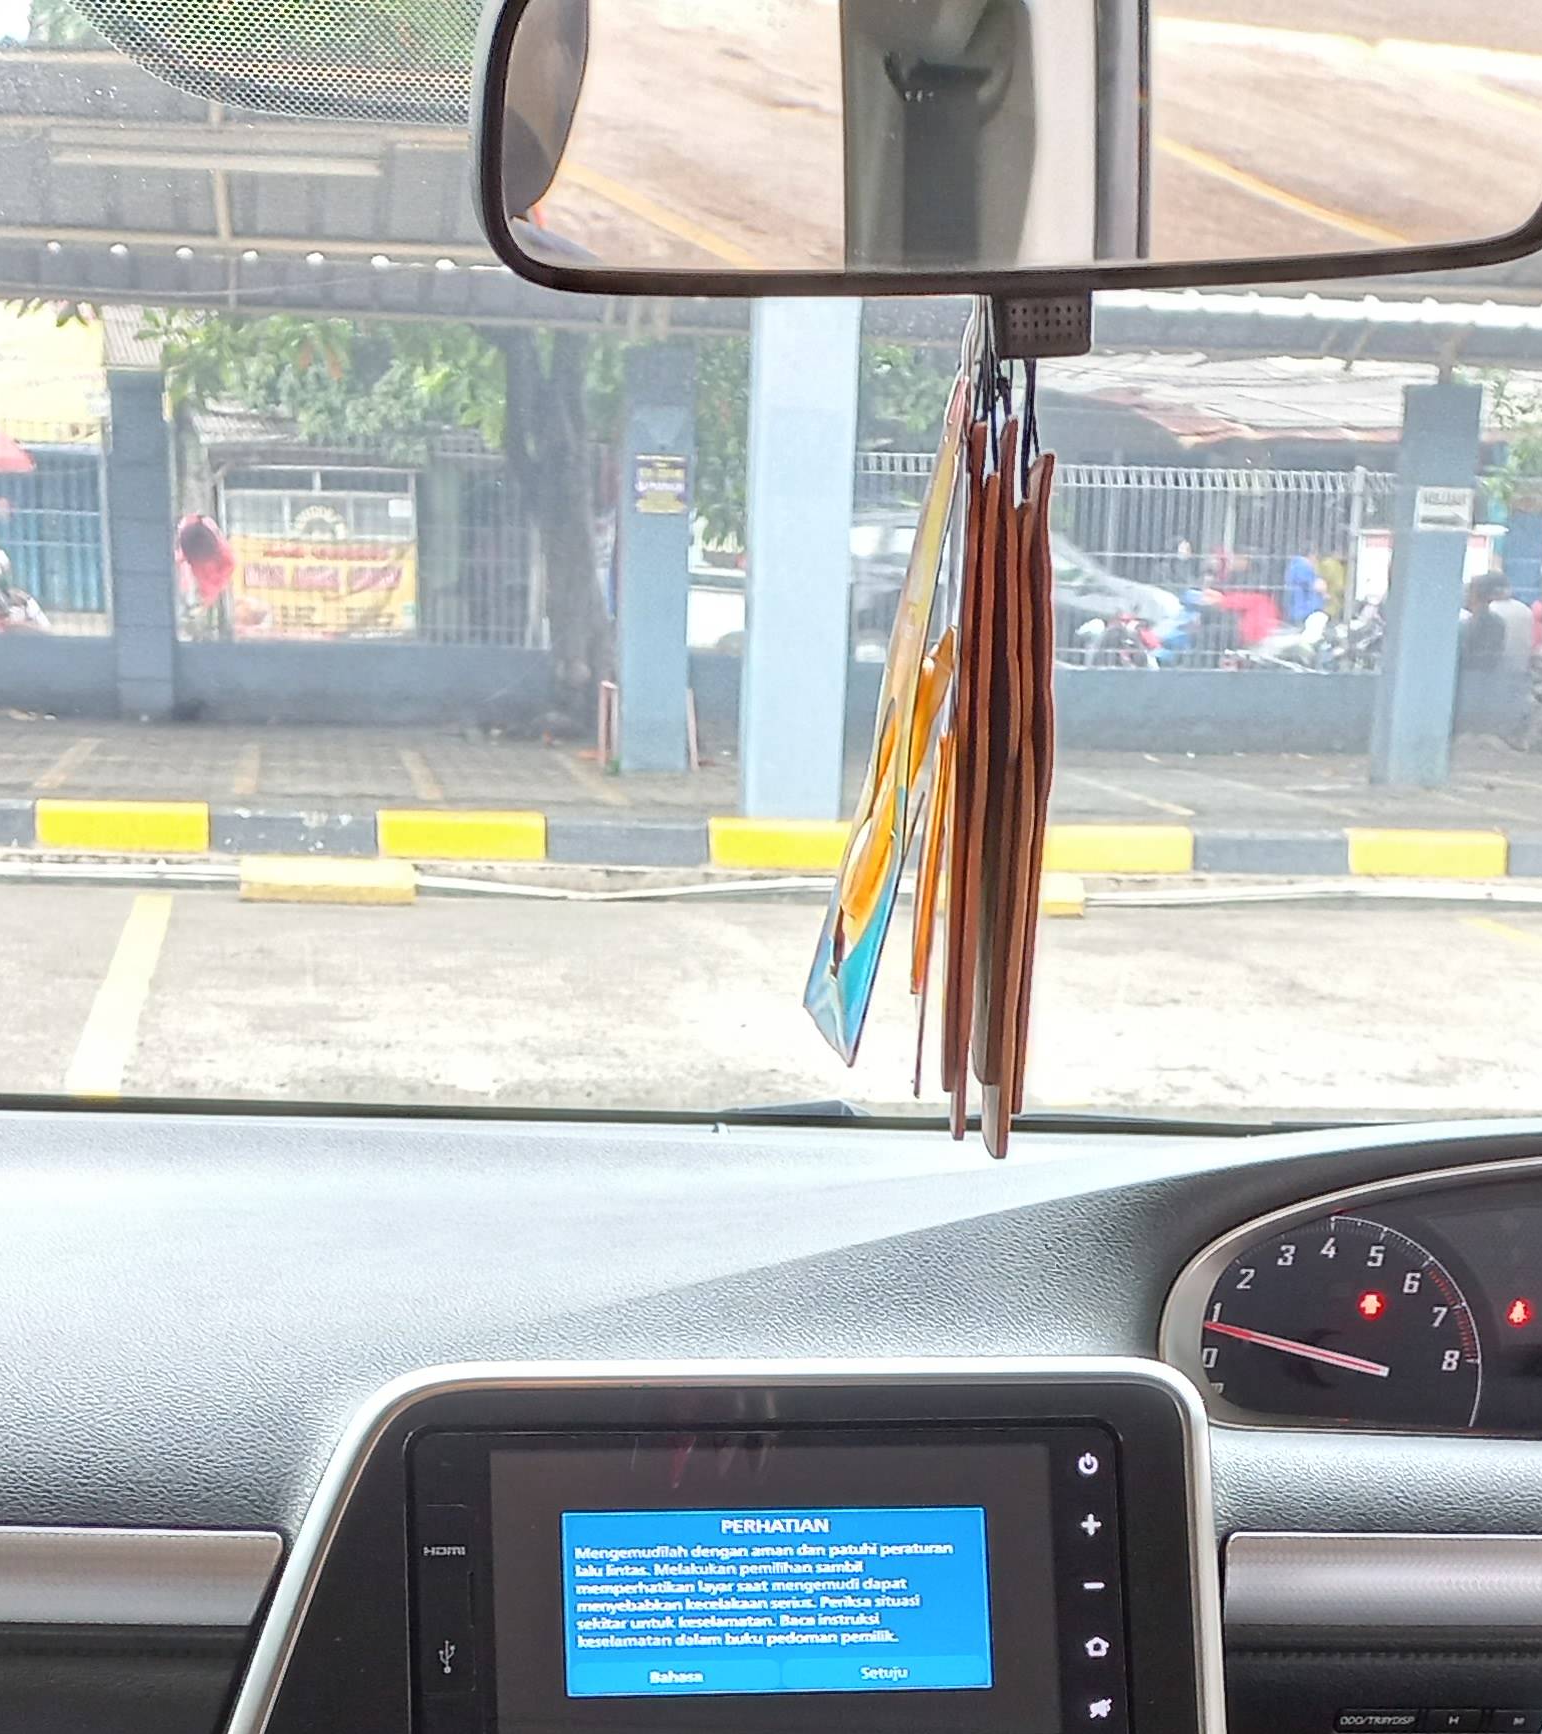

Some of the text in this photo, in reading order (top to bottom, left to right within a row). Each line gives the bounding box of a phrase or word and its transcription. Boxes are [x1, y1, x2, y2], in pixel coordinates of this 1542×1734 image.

[1277, 1245, 1296, 1267] 3
[1320, 1237, 1337, 1259] 4
[1366, 1245, 1385, 1268] 5
[1235, 1267, 1256, 1290] 2
[1402, 1271, 1422, 1294] 6
[1211, 1302, 1223, 1323] 1
[1431, 1306, 1449, 1329] 7
[1201, 1347, 1219, 1369] 0
[1440, 1350, 1460, 1372] 8
[720, 1518, 830, 1534] PERHATIAN
[422, 1545, 467, 1557] HDMI
[574, 1542, 954, 1561] Mengemudilah dengan aman dan patuhi peraturan
[575, 1565, 603, 1577] lalu
[654, 1563, 737, 1576] Melakukan
[739, 1561, 813, 1577] pemilihan
[815, 1560, 864, 1573] sambil
[575, 1577, 908, 1597] memperhatikan layar saat mengemudi dapat
[576, 1599, 683, 1615] menyebabkan
[685, 1597, 768, 1610] kecelakaan
[819, 1595, 872, 1608] Periksa
[874, 1594, 921, 1607] situasi
[576, 1617, 628, 1630] sekitar
[630, 1616, 676, 1629] untuk
[779, 1614, 816, 1627] Baca
[817, 1612, 880, 1625] instruksi
[577, 1635, 673, 1649] keselamatan
[674, 1633, 723, 1646] dalam
[724, 1632, 764, 1645] buku
[766, 1631, 838, 1647] pedoman
[649, 1670, 704, 1684] Bahasa
[861, 1666, 909, 1682] Setuju
